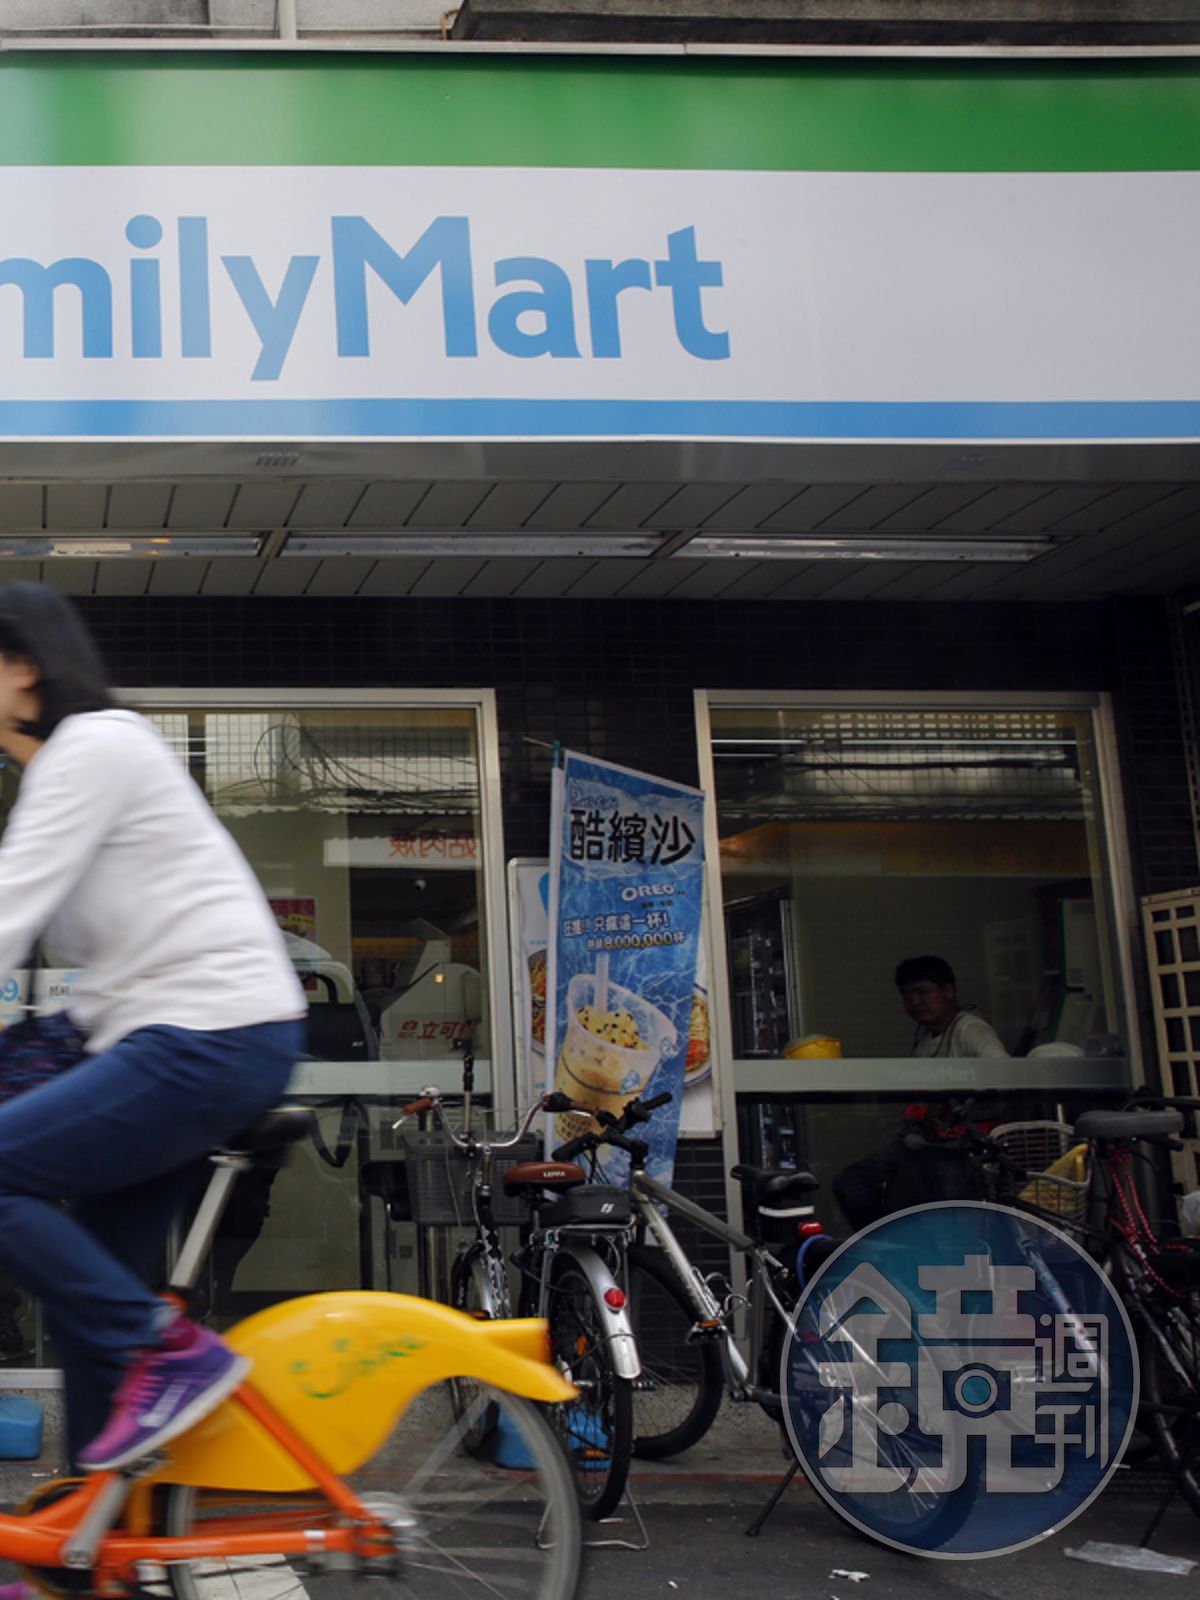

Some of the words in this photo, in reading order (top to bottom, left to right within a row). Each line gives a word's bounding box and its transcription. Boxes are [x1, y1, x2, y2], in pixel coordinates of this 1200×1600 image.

[569, 808, 696, 866] 酷繽沙
[621, 884, 676, 901] OREO
